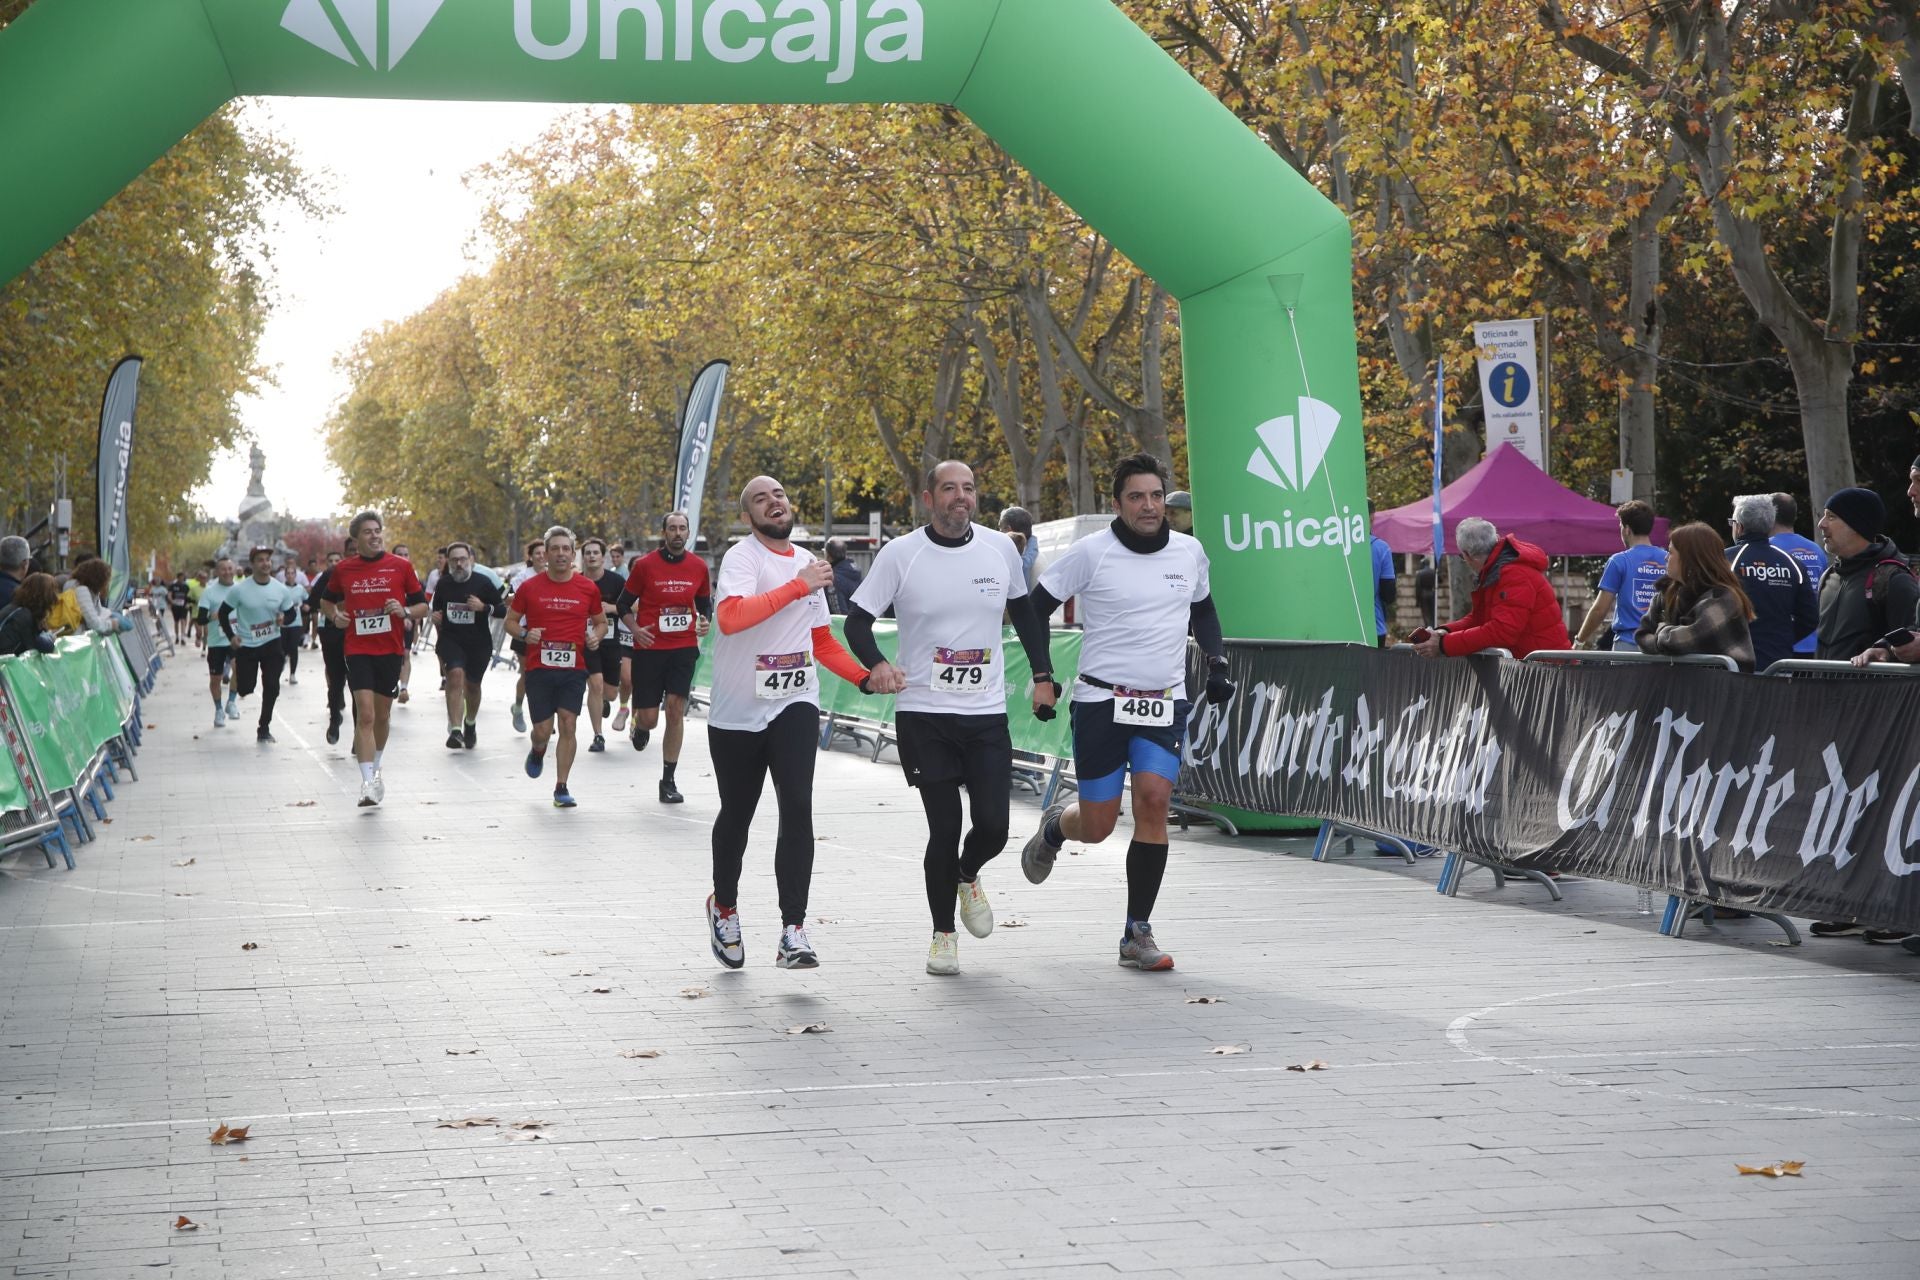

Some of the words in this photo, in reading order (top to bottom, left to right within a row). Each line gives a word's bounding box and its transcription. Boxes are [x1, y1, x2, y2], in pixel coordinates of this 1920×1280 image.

[513, 0, 925, 84] Unicaja
[1482, 331, 1508, 339] Oficina
[1509, 329, 1519, 337] de
[679, 420, 708, 514] nicaja
[1223, 505, 1365, 556] Unicaja
[1637, 565, 1666, 575] elecno
[1740, 562, 1791, 581] ingein
[360, 617, 384, 630] 127
[451, 611, 469, 620] 974
[664, 616, 688, 627] 128
[255, 626, 272, 638] 842
[546, 651, 571, 662] 129
[764, 670, 806, 690] 478
[939, 666, 982, 685] 479
[1121, 698, 1165, 718] 480
[1238, 681, 1344, 781] Norte
[1557, 708, 1638, 833] El
[1631, 706, 1797, 862] Norte
[1796, 740, 1881, 872] de
